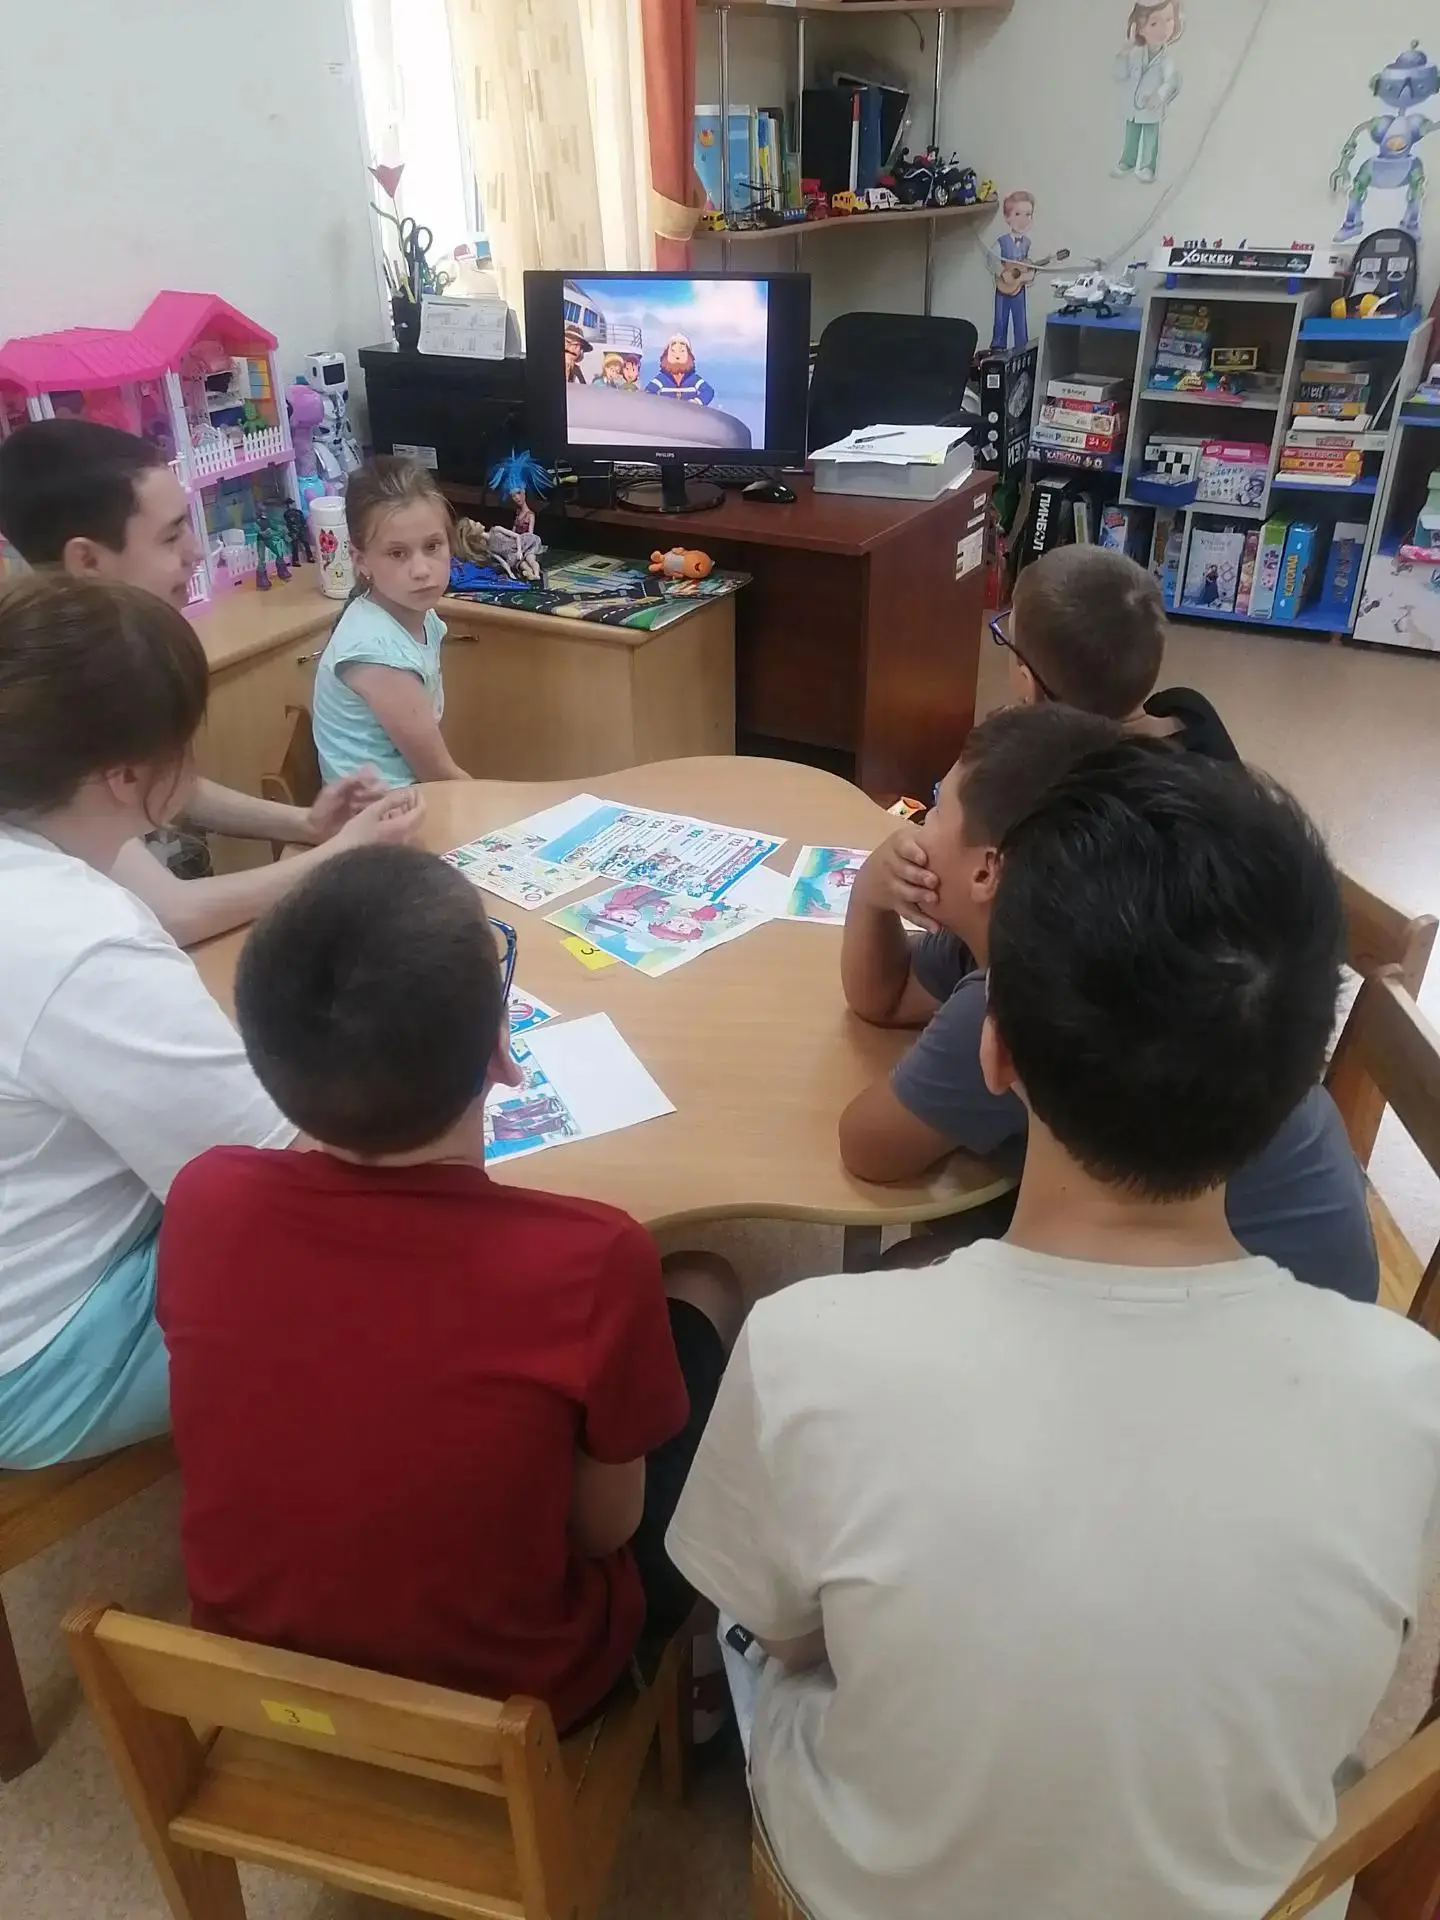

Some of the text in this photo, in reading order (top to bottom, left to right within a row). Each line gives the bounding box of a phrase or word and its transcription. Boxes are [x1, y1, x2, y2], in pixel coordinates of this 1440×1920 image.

[1171, 249, 1234, 266] ХОККЕЙ
[1045, 449, 1081, 463] КАПИТАЛ
[1033, 493, 1051, 551] ПИНБОЛ
[284, 1708, 300, 1724] 3
